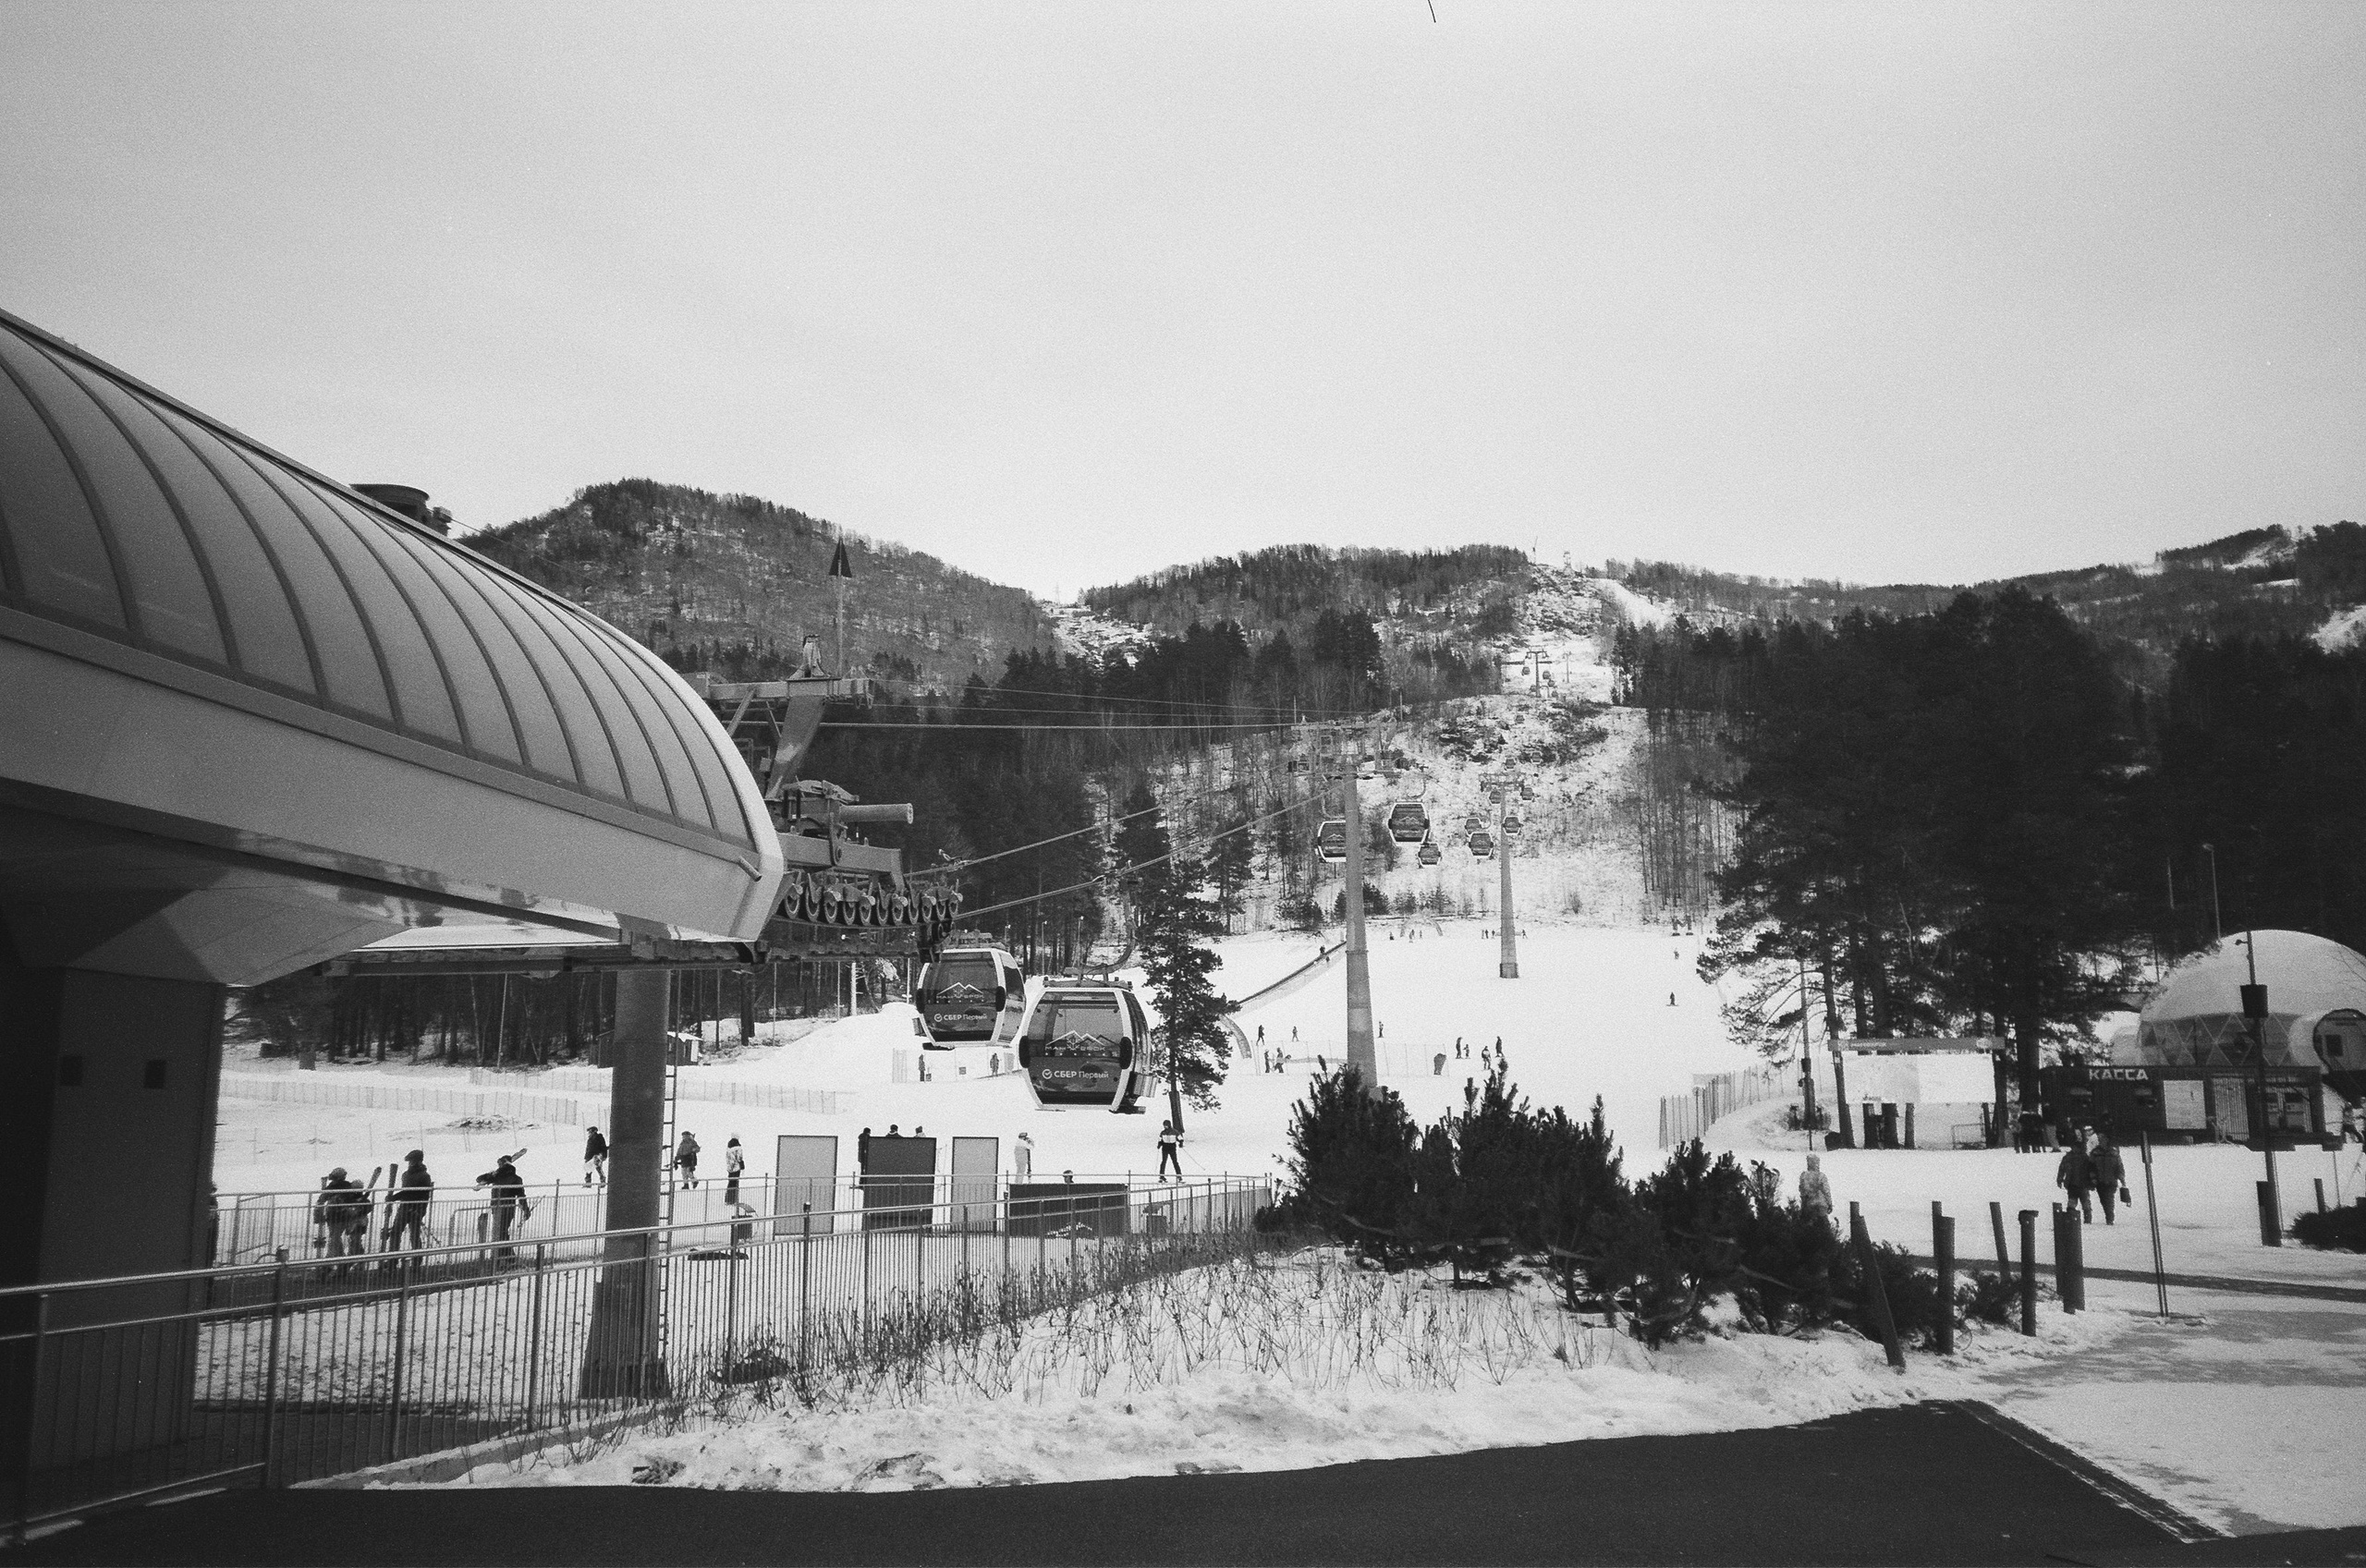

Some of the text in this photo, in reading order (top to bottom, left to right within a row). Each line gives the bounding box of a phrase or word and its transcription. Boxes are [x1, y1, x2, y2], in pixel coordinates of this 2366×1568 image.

[1054, 1070, 1109, 1079] СБЕР Первый
[2089, 1068, 2149, 1081] КАССА
